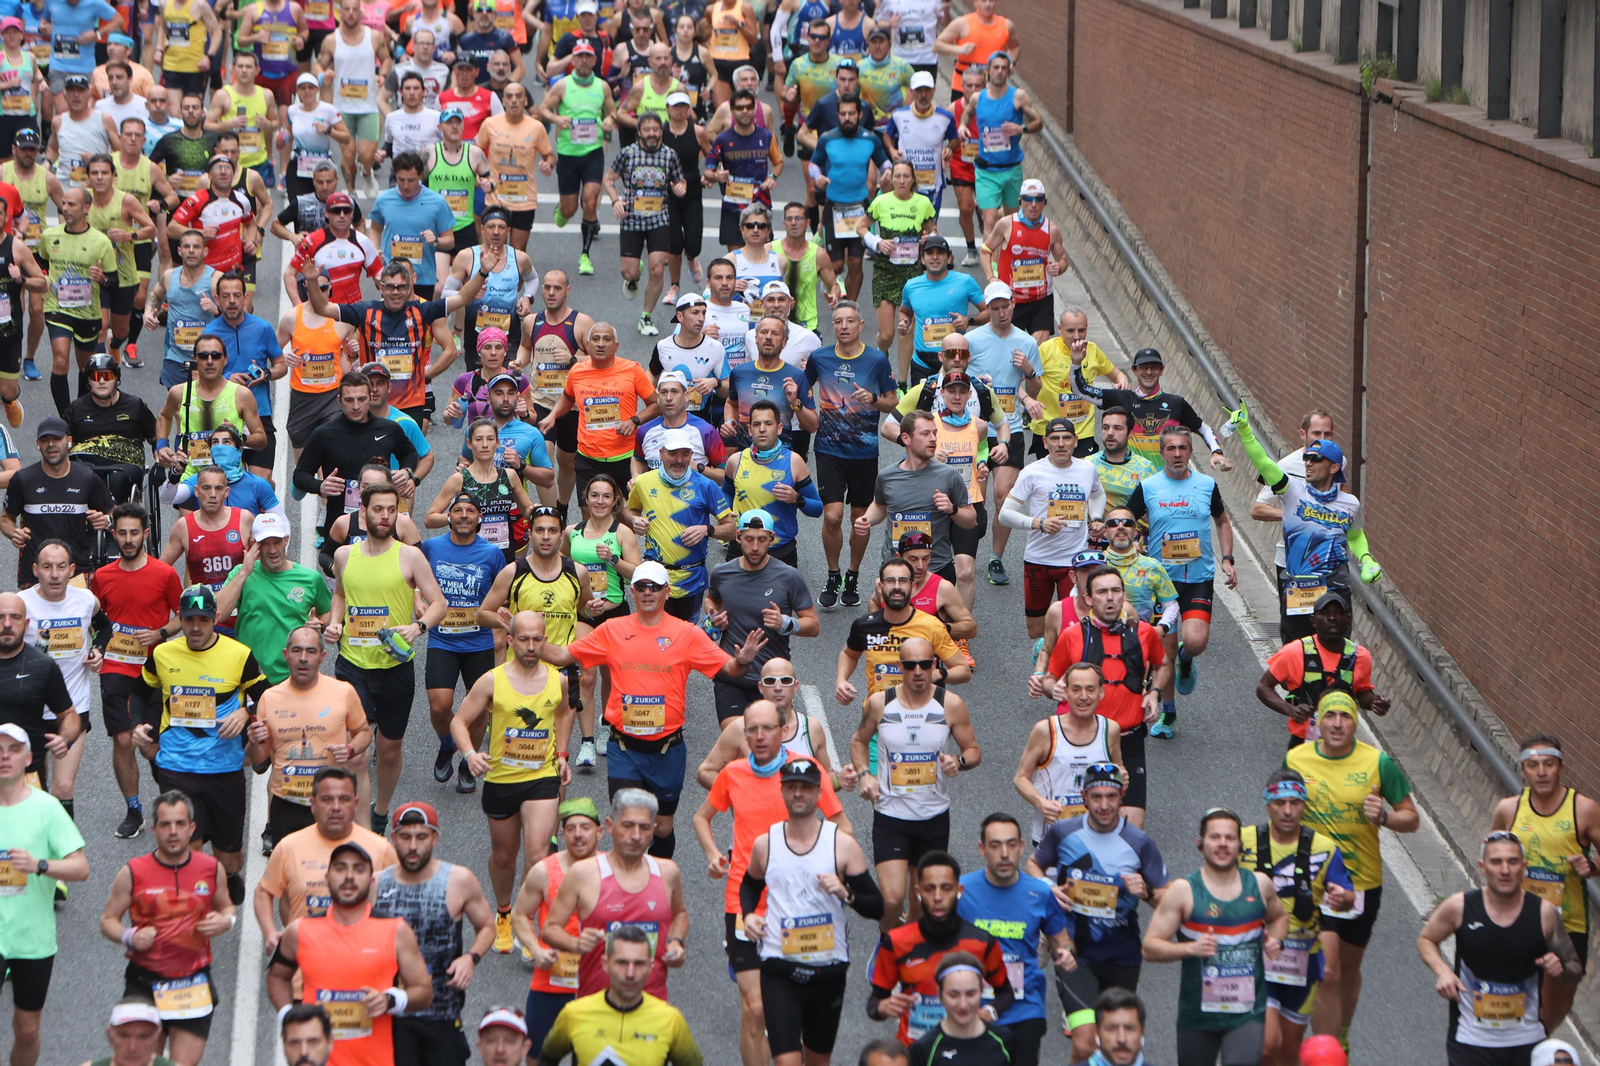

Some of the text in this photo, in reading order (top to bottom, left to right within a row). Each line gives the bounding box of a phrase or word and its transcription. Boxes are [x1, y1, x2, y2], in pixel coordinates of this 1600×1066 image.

[599, 389, 625, 397] Athletes
[939, 441, 974, 453] ANGELICA
[40, 504, 76, 513] Club226
[480, 505, 510, 514] ONTIJO
[1172, 532, 1195, 540] ZURICH
[202, 555, 233, 574] 360
[446, 580, 463, 590] MEIA
[359, 607, 384, 615] ZURICH
[53, 618, 79, 628] ZURICH
[54, 632, 69, 640] 4204
[120, 638, 134, 646] 4924
[127, 649, 145, 657] SALAS
[618, 662, 632, 671] LOS
[185, 687, 211, 695] ZURICH
[634, 696, 660, 704] ZURICH
[634, 709, 650, 717] 5047
[278, 725, 302, 734] Maratón
[520, 730, 546, 738] ZURICH
[518, 743, 535, 751] 5044
[504, 751, 546, 761] PAULO CALDEIRA
[905, 753, 932, 761] ZURICH
[904, 767, 921, 775] 5851
[1085, 874, 1114, 884] ZURICH
[1529, 872, 1559, 881] ZURICH
[797, 917, 828, 927] ZURICH
[1220, 968, 1250, 977] ZURICH
[1492, 985, 1521, 995] ZURICH
[333, 990, 364, 1000] ZURICH
